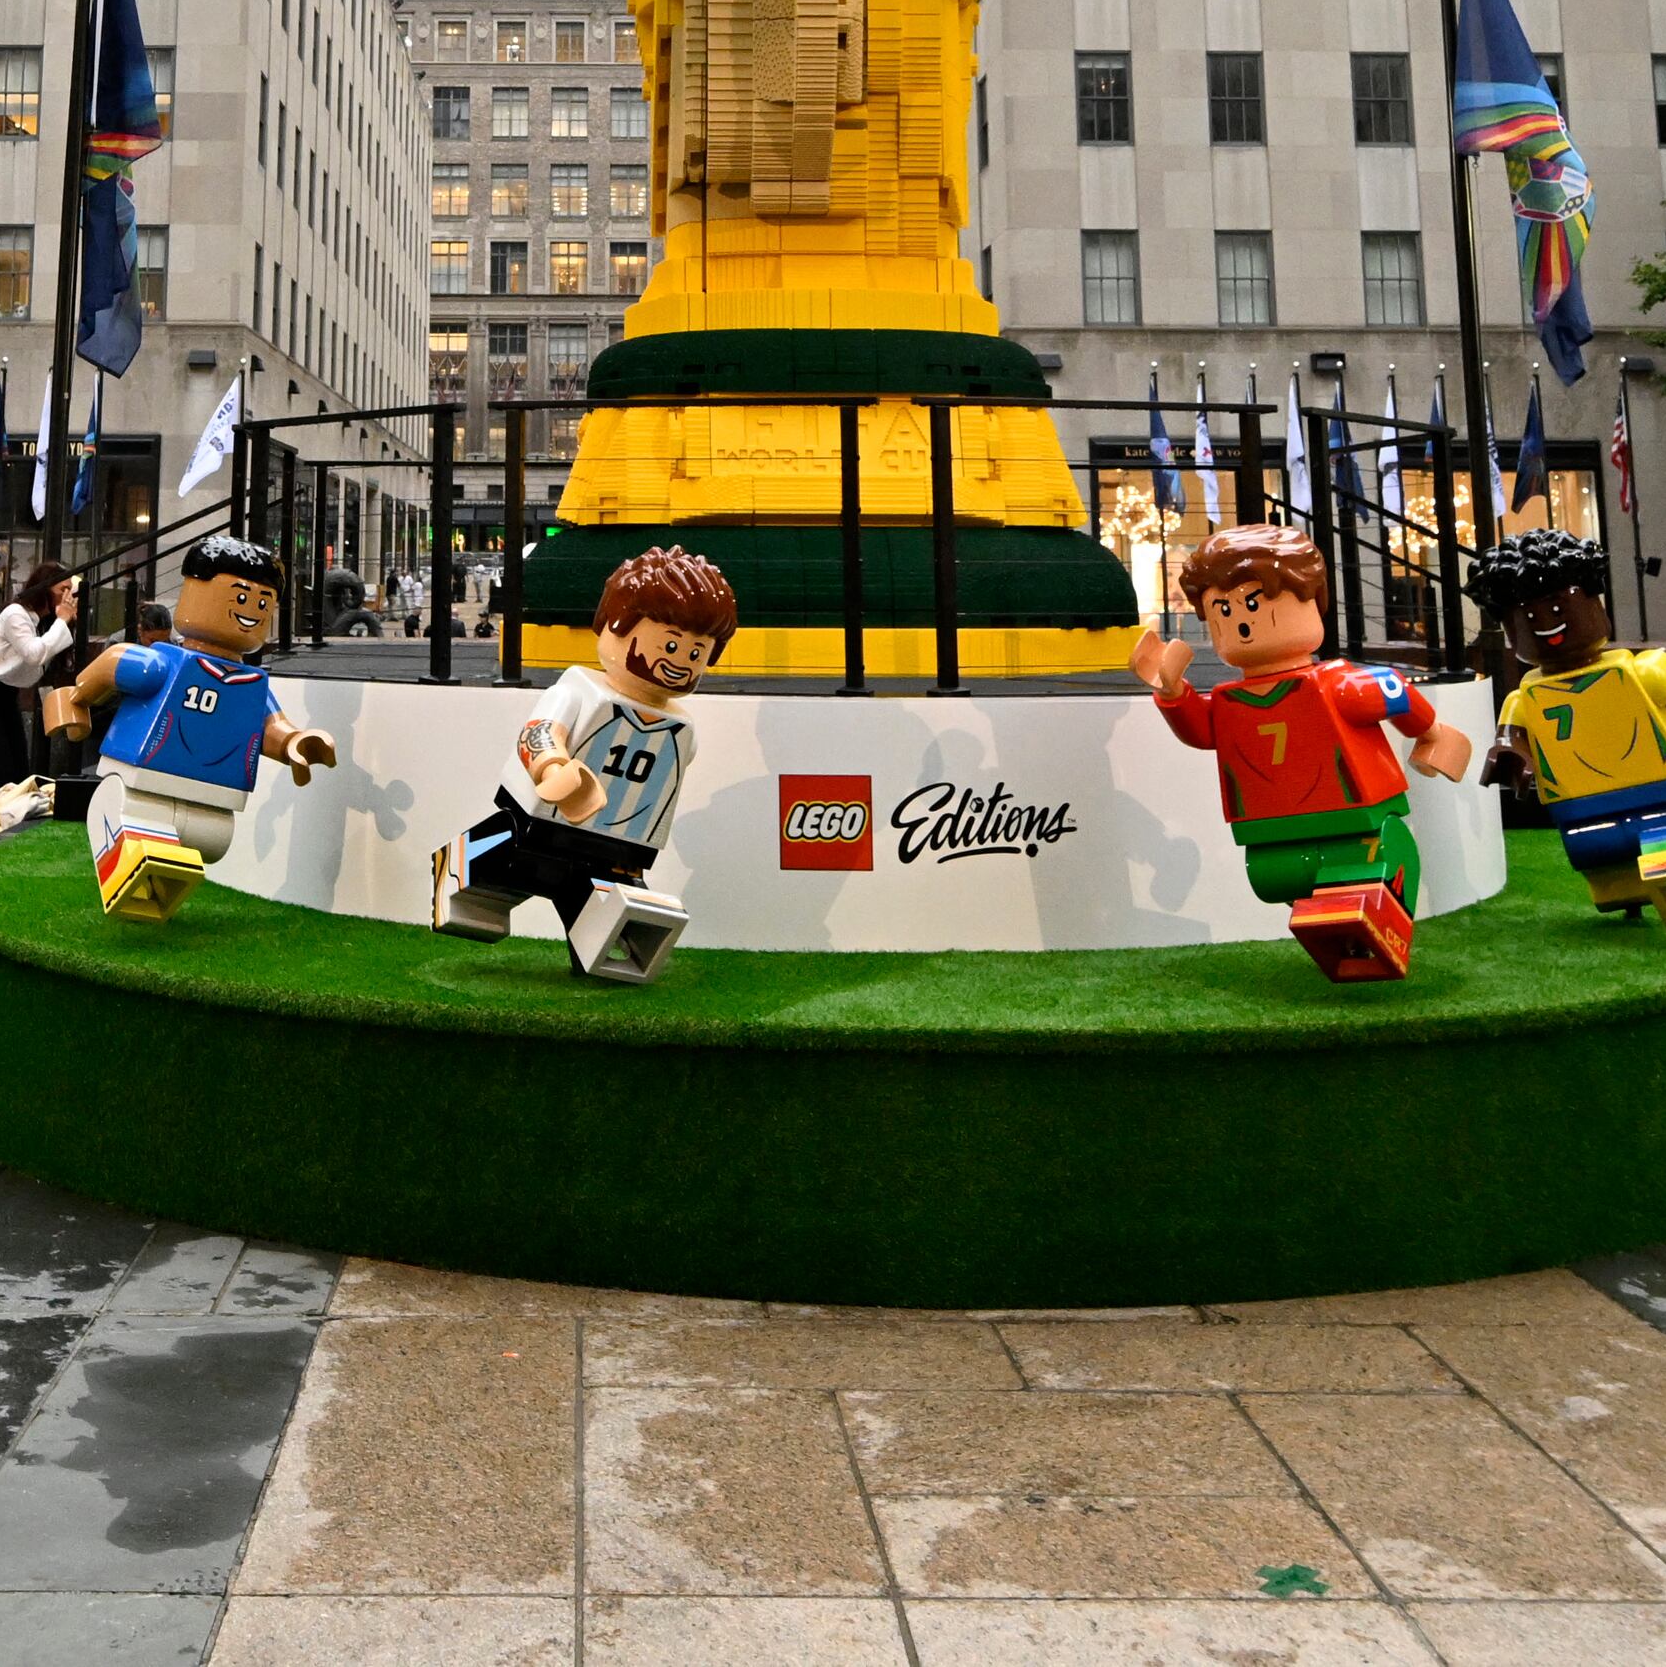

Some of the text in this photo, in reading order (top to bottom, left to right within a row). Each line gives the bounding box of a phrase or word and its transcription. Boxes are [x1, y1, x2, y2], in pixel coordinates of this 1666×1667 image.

[879, 448, 928, 471] CU
[183, 685, 219, 714] 10
[1543, 704, 1573, 741] 7
[1257, 722, 1287, 765] 7
[601, 744, 656, 784] 10
[785, 801, 867, 842] LEGO
[890, 781, 1078, 864] Editions
[1361, 837, 1381, 863] 7
